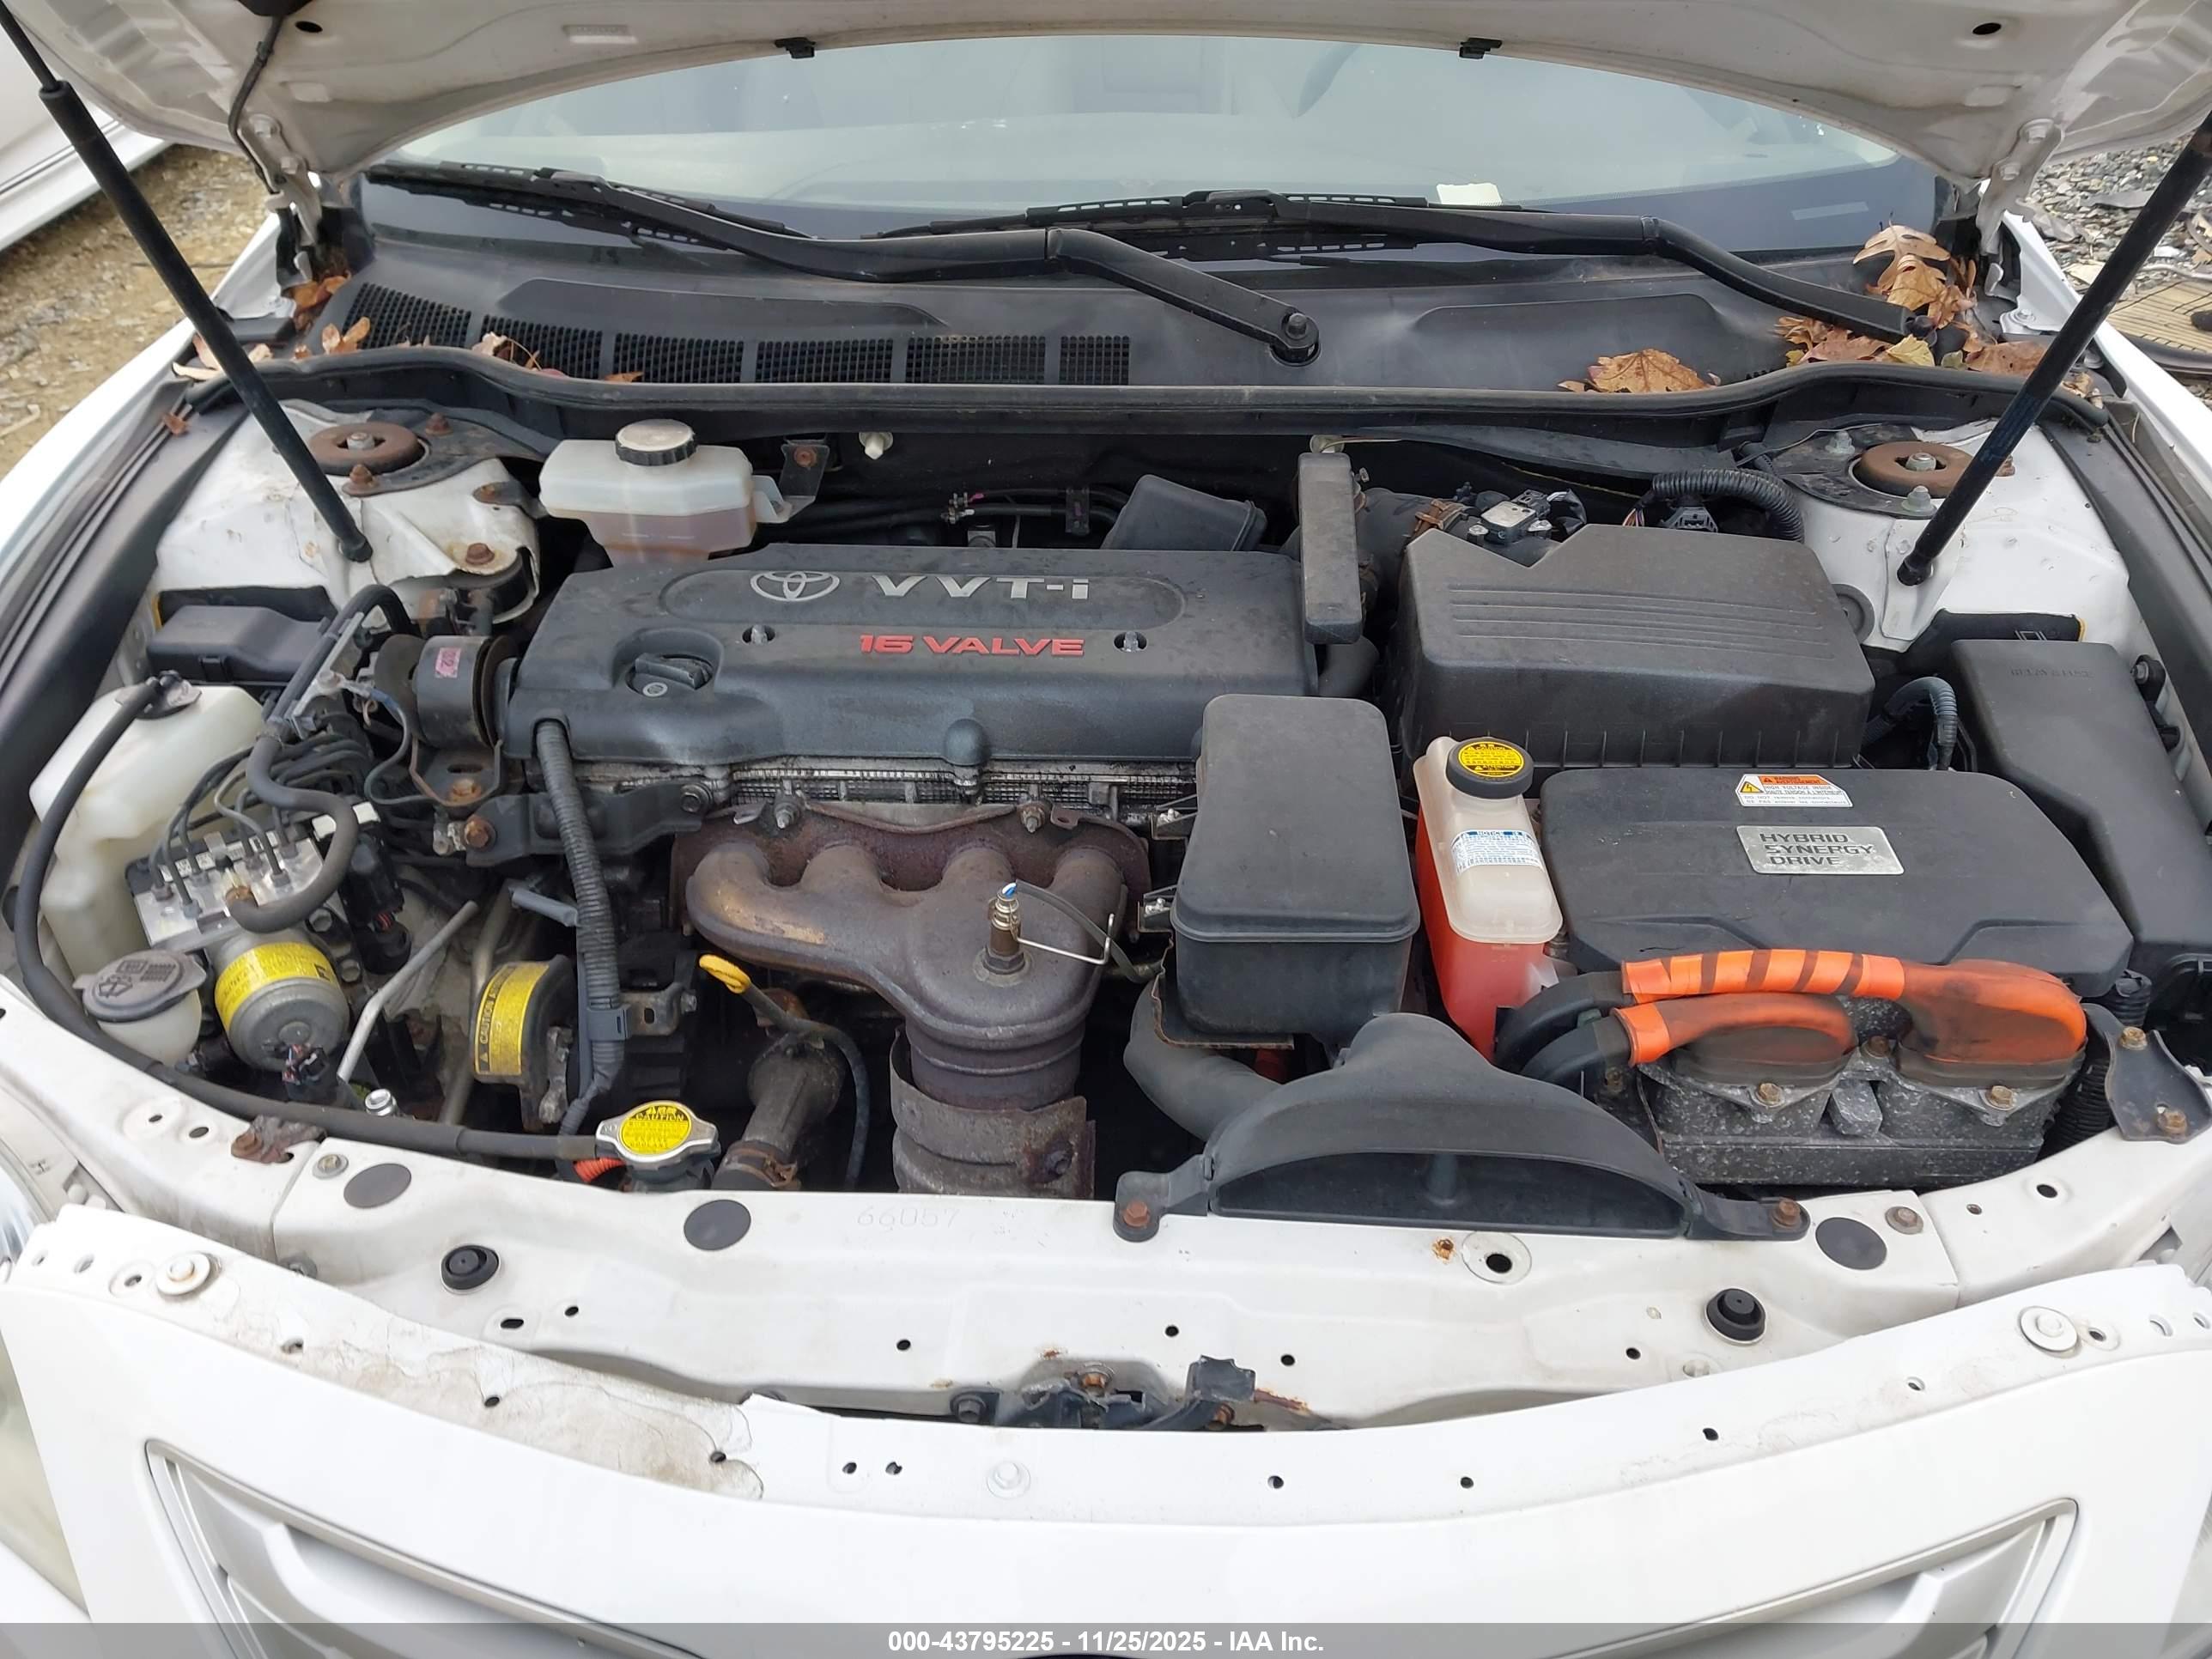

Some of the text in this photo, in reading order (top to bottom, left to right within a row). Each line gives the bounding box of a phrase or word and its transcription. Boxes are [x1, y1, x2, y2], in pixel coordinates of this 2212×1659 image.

[872, 574, 1090, 599] VVT-i
[860, 634, 1085, 656] 16 VALVE
[1759, 833, 1849, 842] HYBRID
[1765, 845, 1873, 854] SYNERGY
[1769, 856, 1841, 865] DRIVE
[479, 1000, 495, 1044] CAUTION
[635, 1112, 684, 1121] CAUTION
[857, 1205, 960, 1228] 66057
